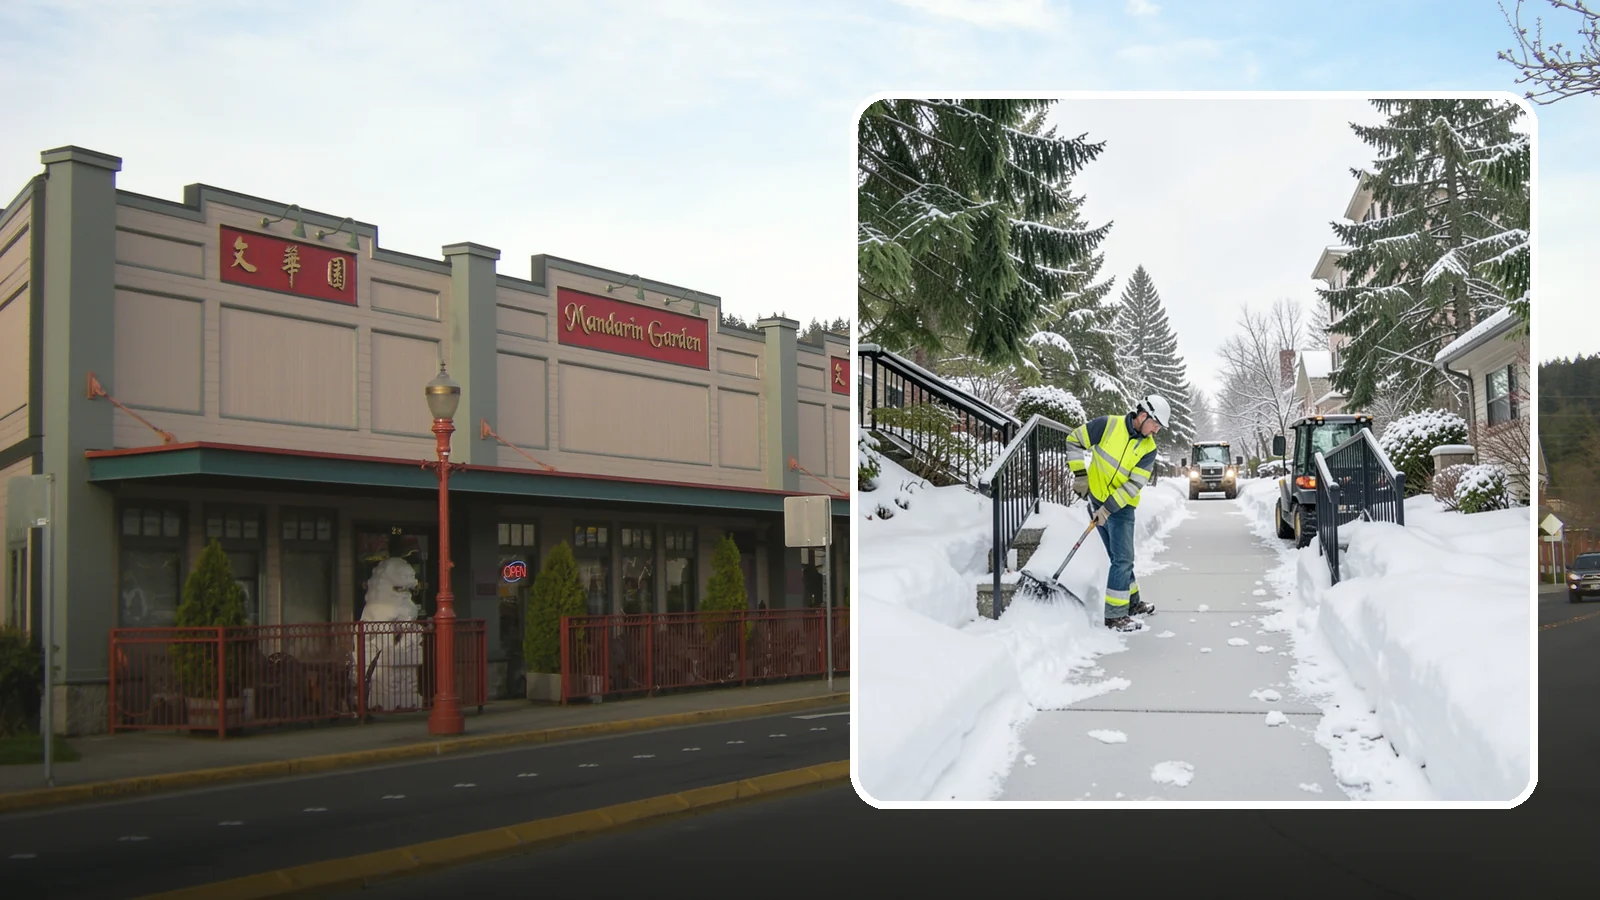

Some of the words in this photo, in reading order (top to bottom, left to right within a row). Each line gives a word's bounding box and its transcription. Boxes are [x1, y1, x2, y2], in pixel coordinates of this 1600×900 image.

[564, 302, 644, 341] Mandarin
[647, 320, 701, 352] Garden
[503, 565, 527, 578] OPEN
